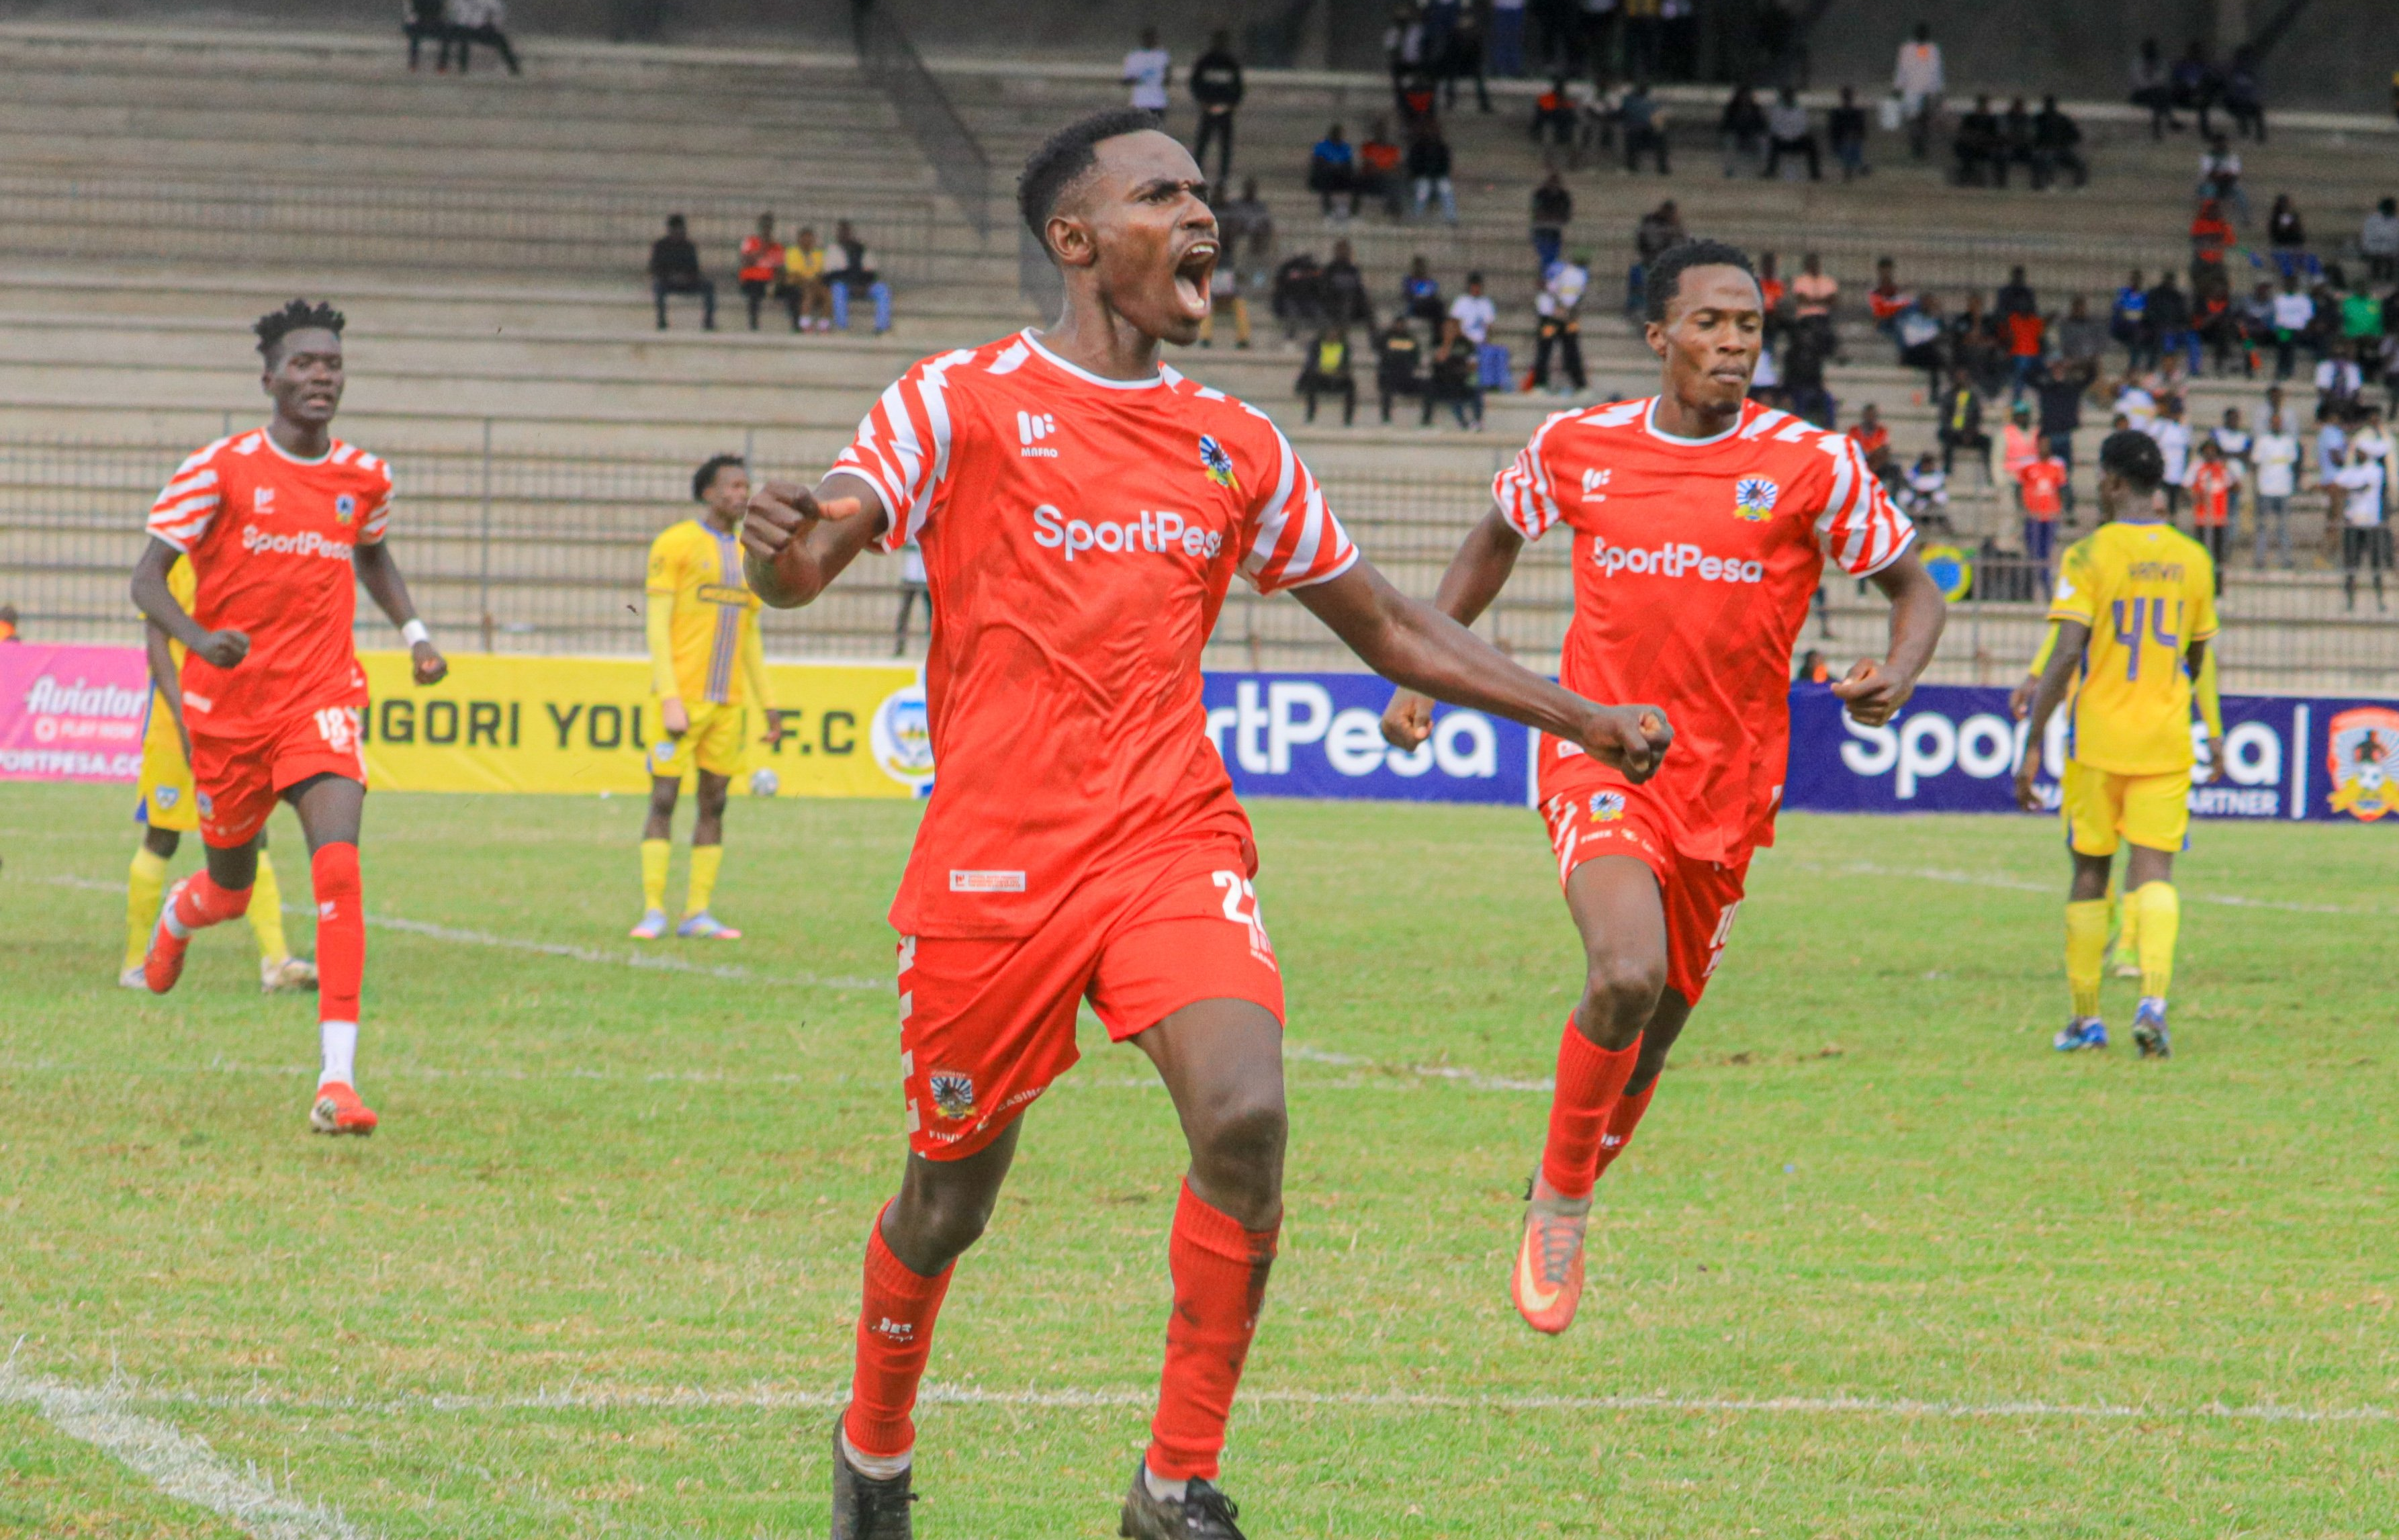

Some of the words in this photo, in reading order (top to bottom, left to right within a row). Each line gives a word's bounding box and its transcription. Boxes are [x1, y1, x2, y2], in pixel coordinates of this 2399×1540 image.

[1033, 504, 1222, 561] SportPes
[1592, 535, 1763, 583] SportPesa
[0, 749, 143, 776] ORTPESA.C
[2186, 788, 2279, 815] ARTNER
